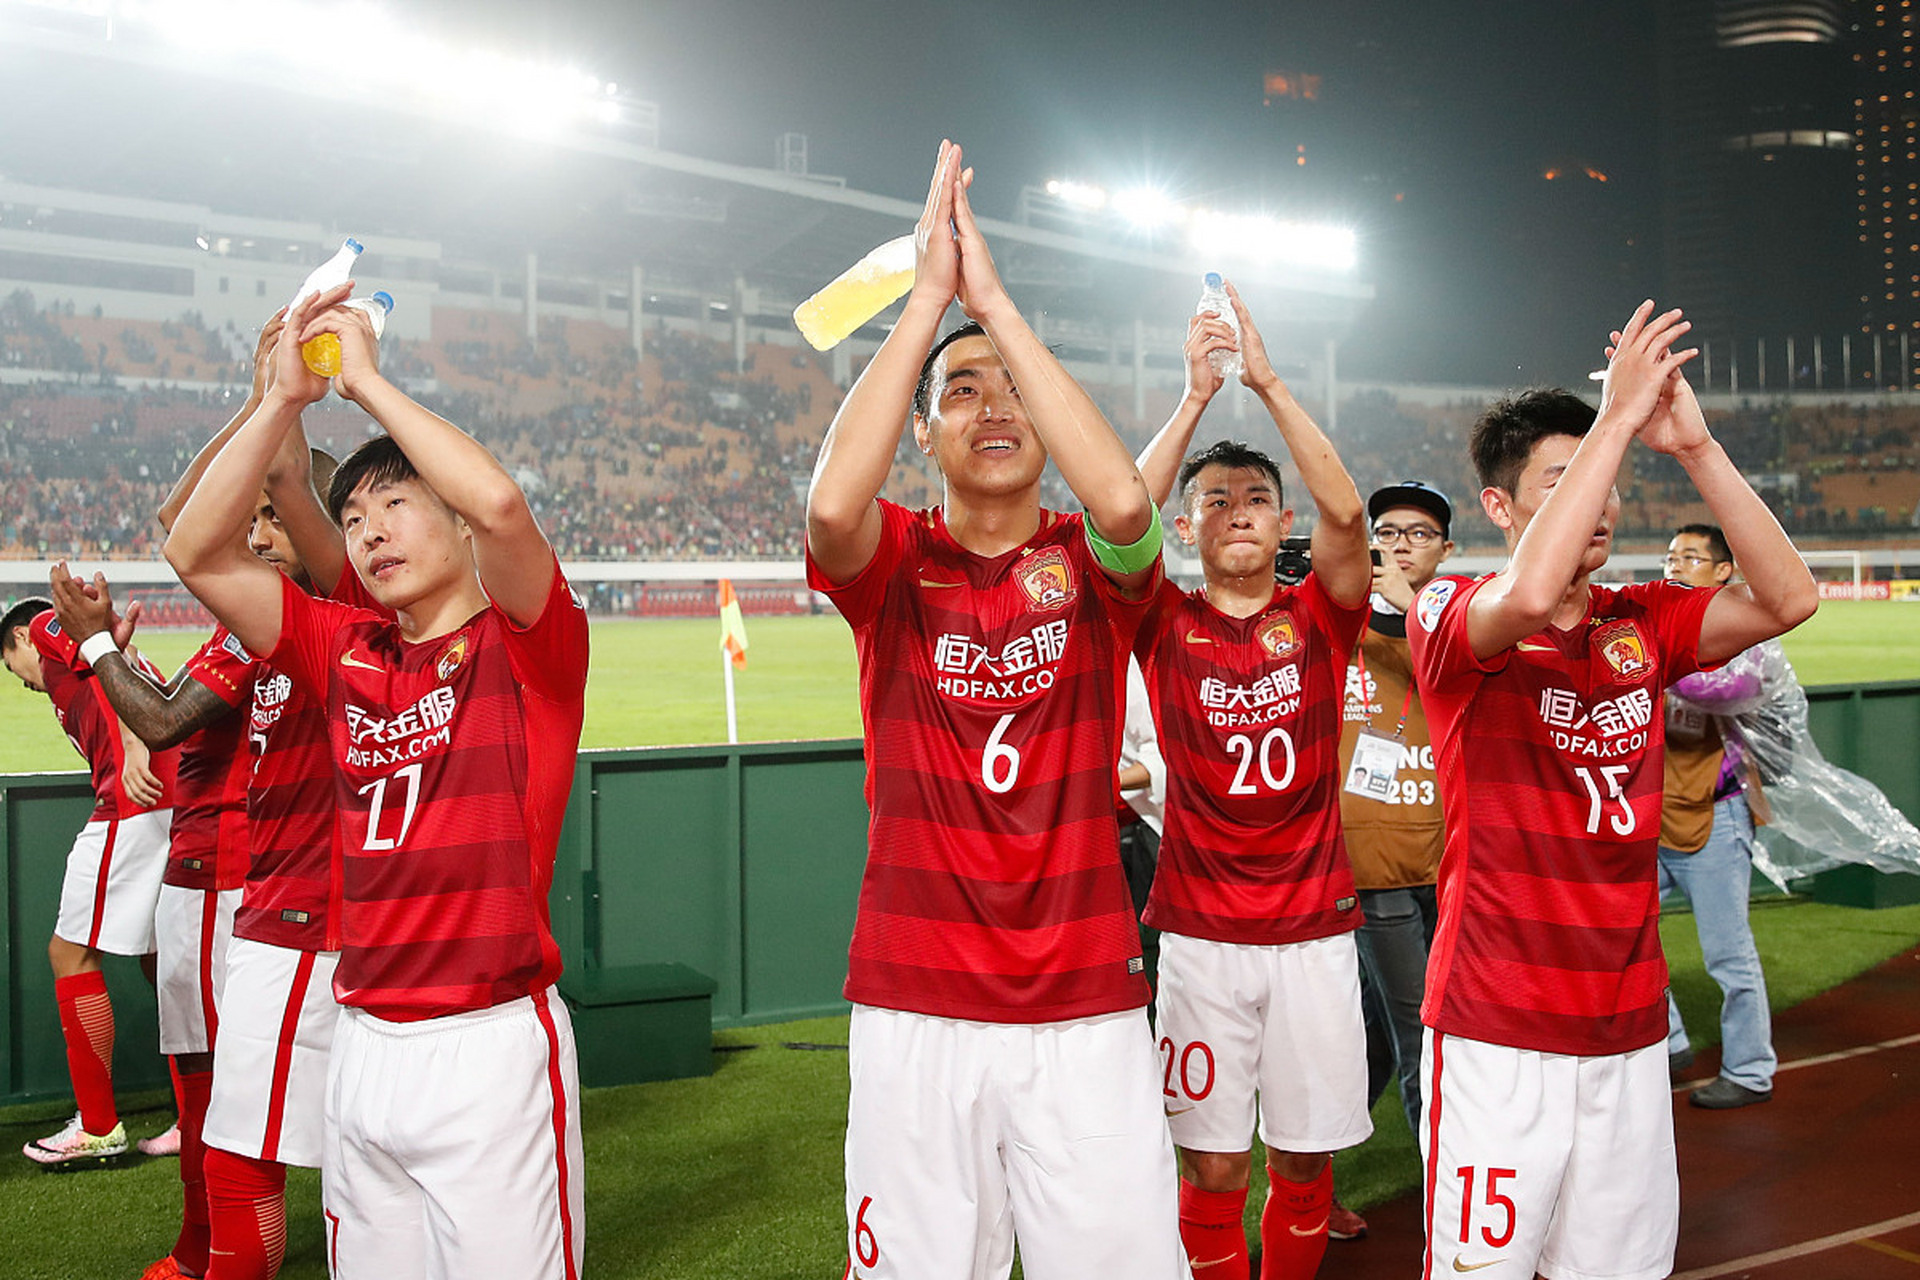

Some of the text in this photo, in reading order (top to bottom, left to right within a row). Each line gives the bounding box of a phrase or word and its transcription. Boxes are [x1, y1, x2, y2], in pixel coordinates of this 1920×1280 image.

[1818, 583, 1889, 600] Emirtes
[933, 619, 1068, 678] 恒大金服
[936, 667, 1059, 699] HDFAX.CO
[1200, 663, 1302, 710] 恒大金服
[981, 714, 1021, 794] 6
[1226, 727, 1297, 795] 20
[1397, 745, 1436, 770] NG
[1550, 730, 1648, 757] DFAX.CO
[358, 763, 423, 851] 27
[1386, 779, 1436, 806] 293
[1574, 765, 1637, 836] 15
[1159, 1036, 1216, 1102] 20
[855, 1196, 880, 1269] 6
[1456, 1165, 1517, 1249] 15
